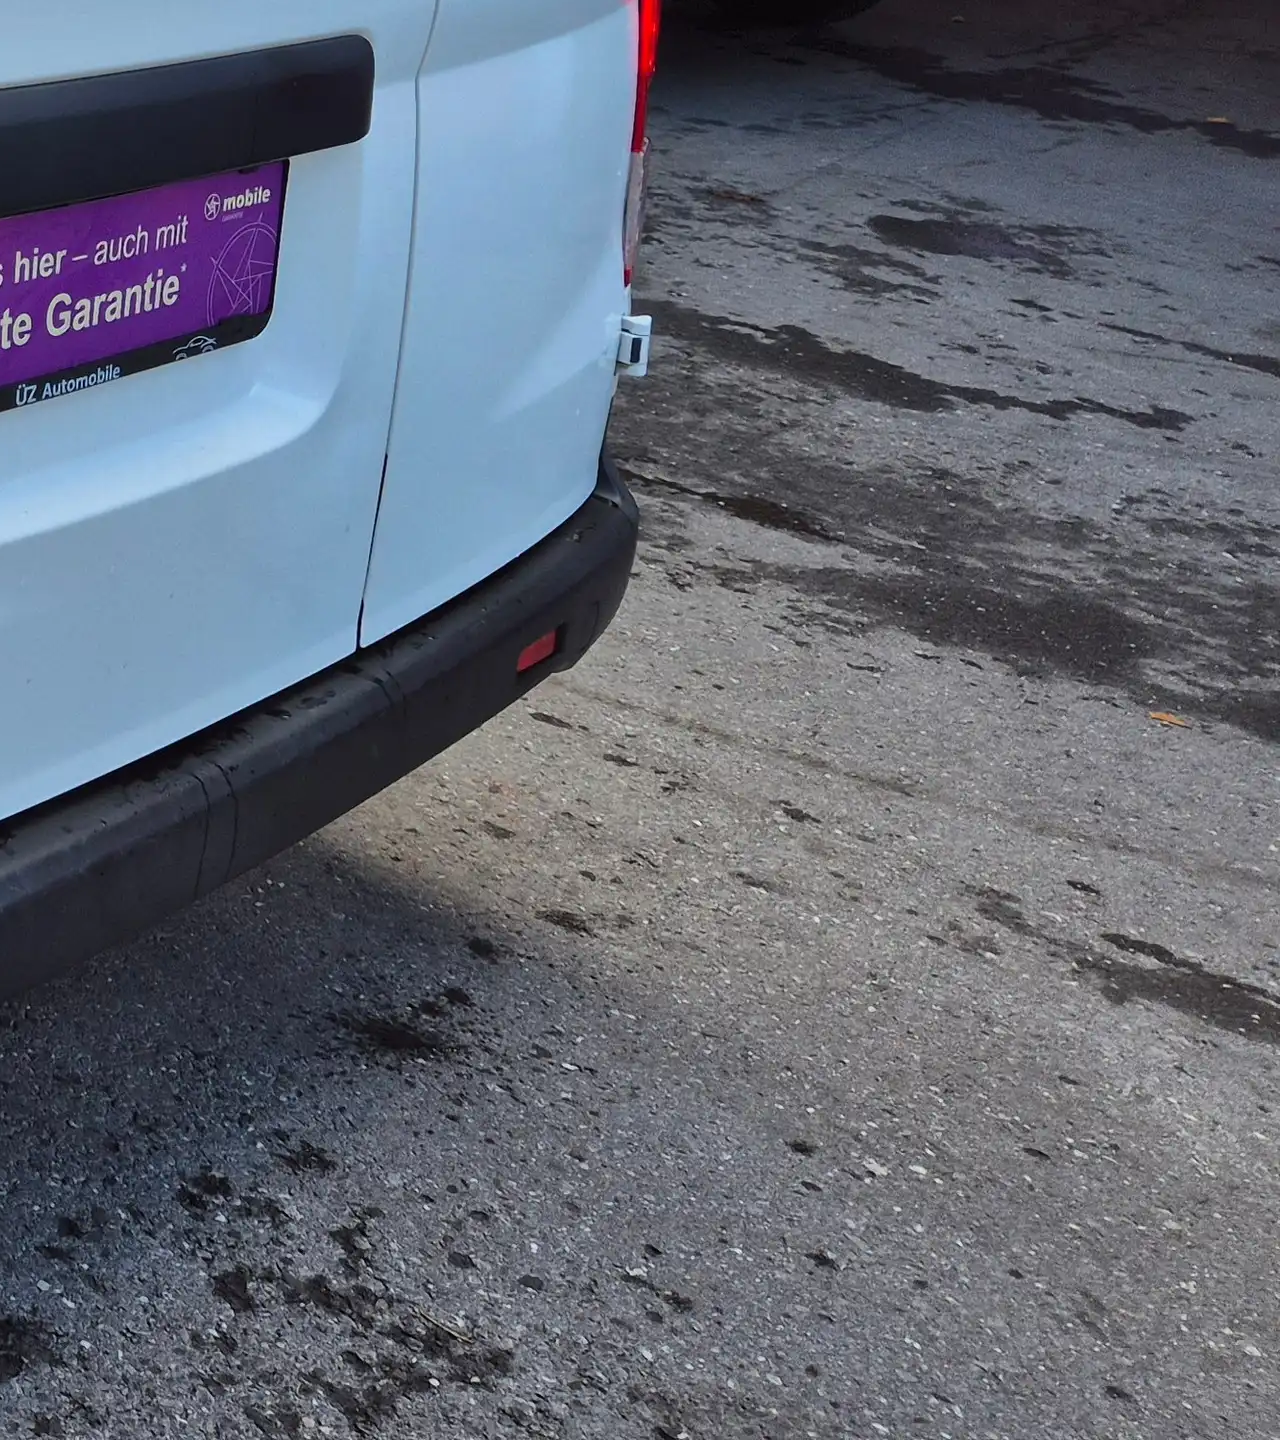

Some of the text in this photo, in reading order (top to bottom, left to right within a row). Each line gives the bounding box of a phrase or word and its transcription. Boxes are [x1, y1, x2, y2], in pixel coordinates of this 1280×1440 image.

[222, 185, 271, 212] mobile
[13, 247, 68, 284] hier
[93, 224, 149, 266] auch
[155, 214, 189, 250] mit
[14, 364, 121, 406] ÜZ Automobile
